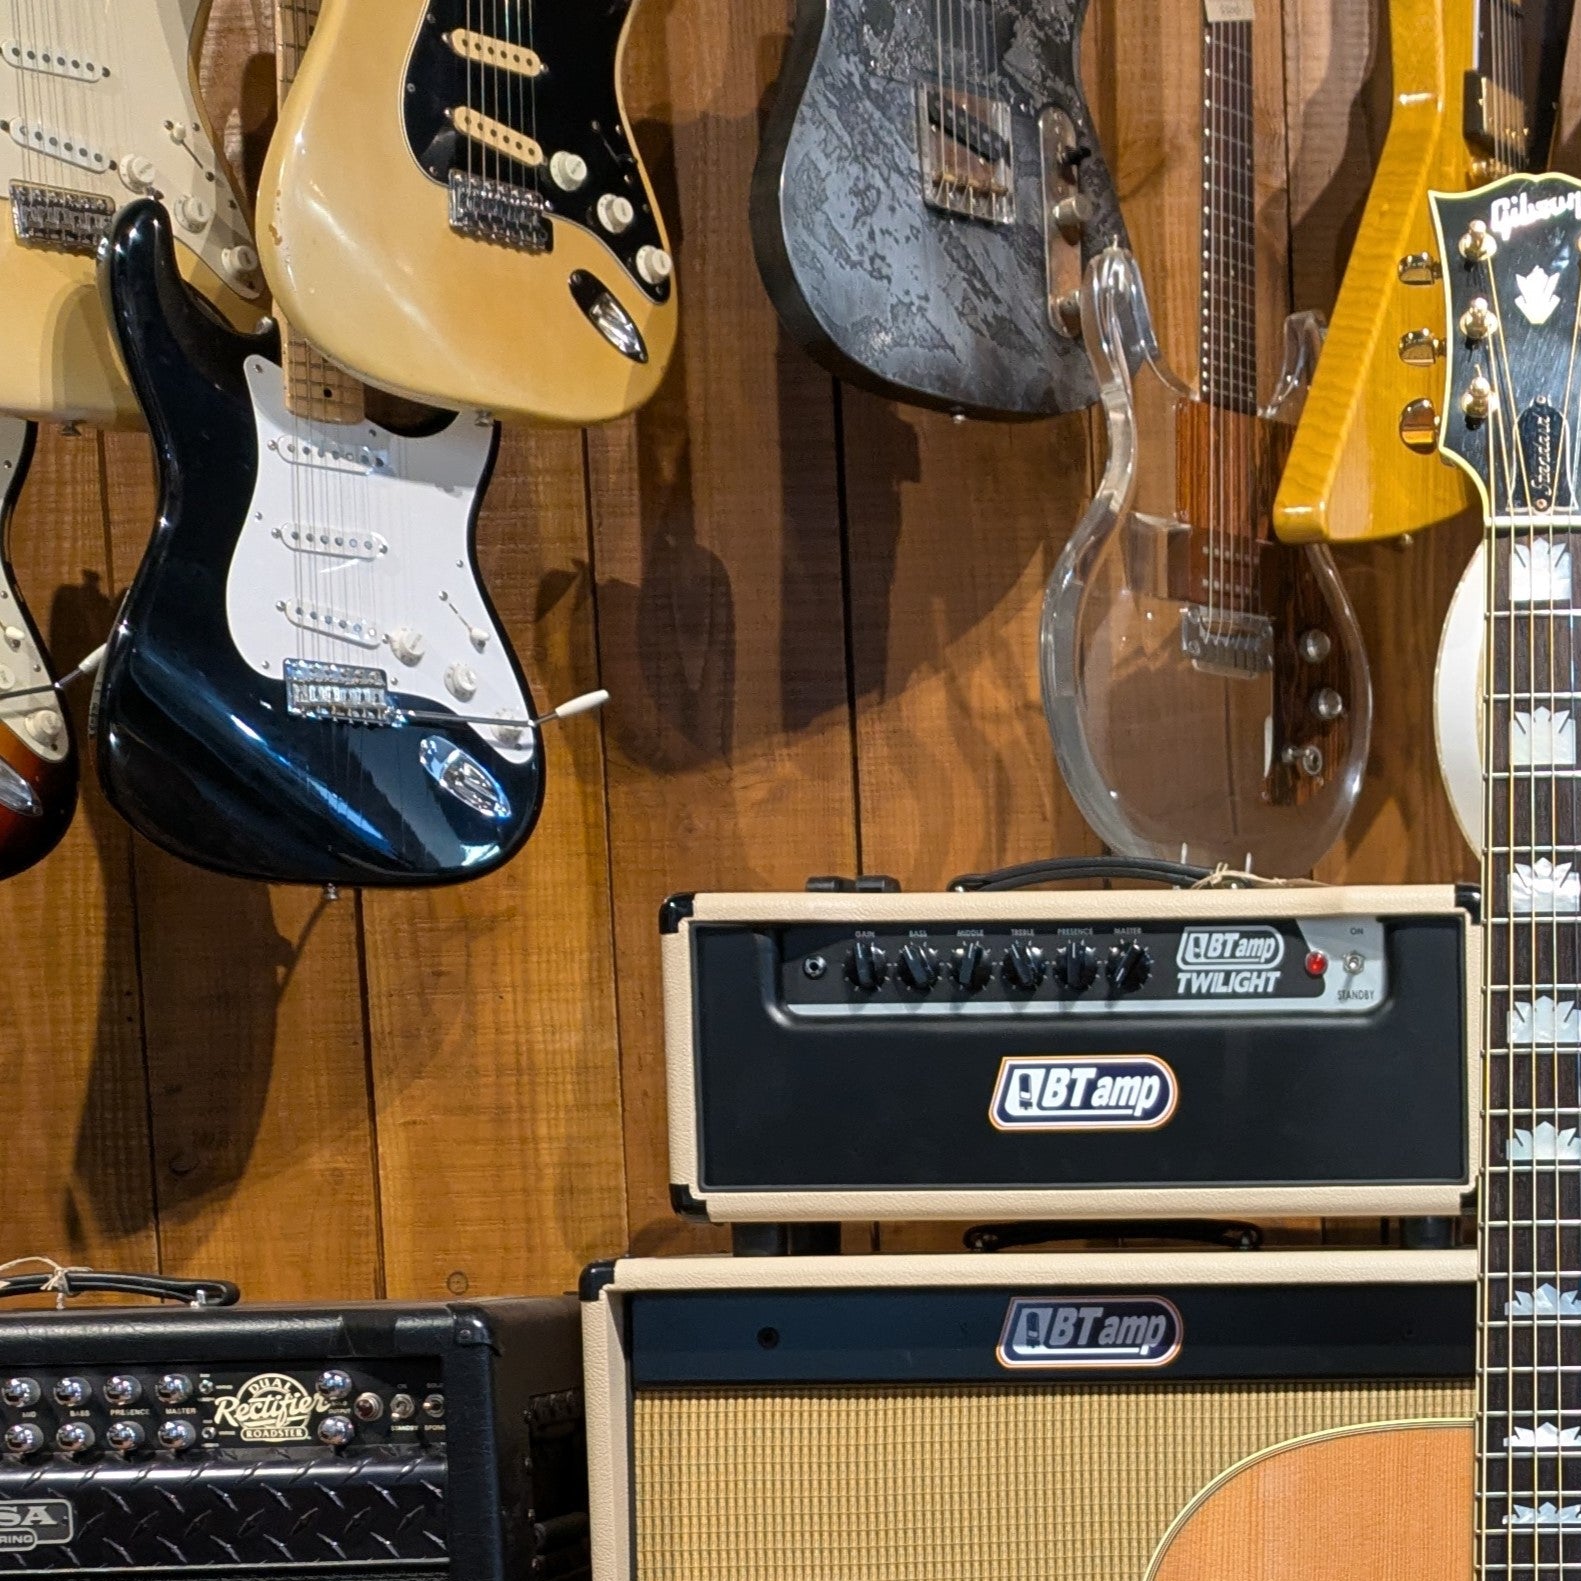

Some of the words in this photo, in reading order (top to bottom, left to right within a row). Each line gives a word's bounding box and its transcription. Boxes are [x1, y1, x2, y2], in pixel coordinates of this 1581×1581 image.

[854, 930, 876, 938] GAIN
[908, 929, 928, 938] BASS
[956, 928, 984, 937] MIDDLE
[1010, 928, 1035, 937] TREBLE
[1057, 927, 1093, 936] PRESENCE
[1113, 926, 1142, 935] MASTER
[1235, 936, 1276, 963] amp
[1177, 971, 1281, 994] TWILIGHT
[1337, 989, 1375, 1000] STANDBY
[1091, 1074, 1160, 1117] amp
[1098, 1314, 1167, 1356] amp
[249, 1379, 292, 1395] DUAL
[69, 1409, 91, 1418] BASS
[109, 1408, 151, 1416] PRESENCE
[164, 1406, 198, 1415] MASTER
[213, 1391, 332, 1428] Rectifier
[246, 1428, 304, 1439] ROADSTER
